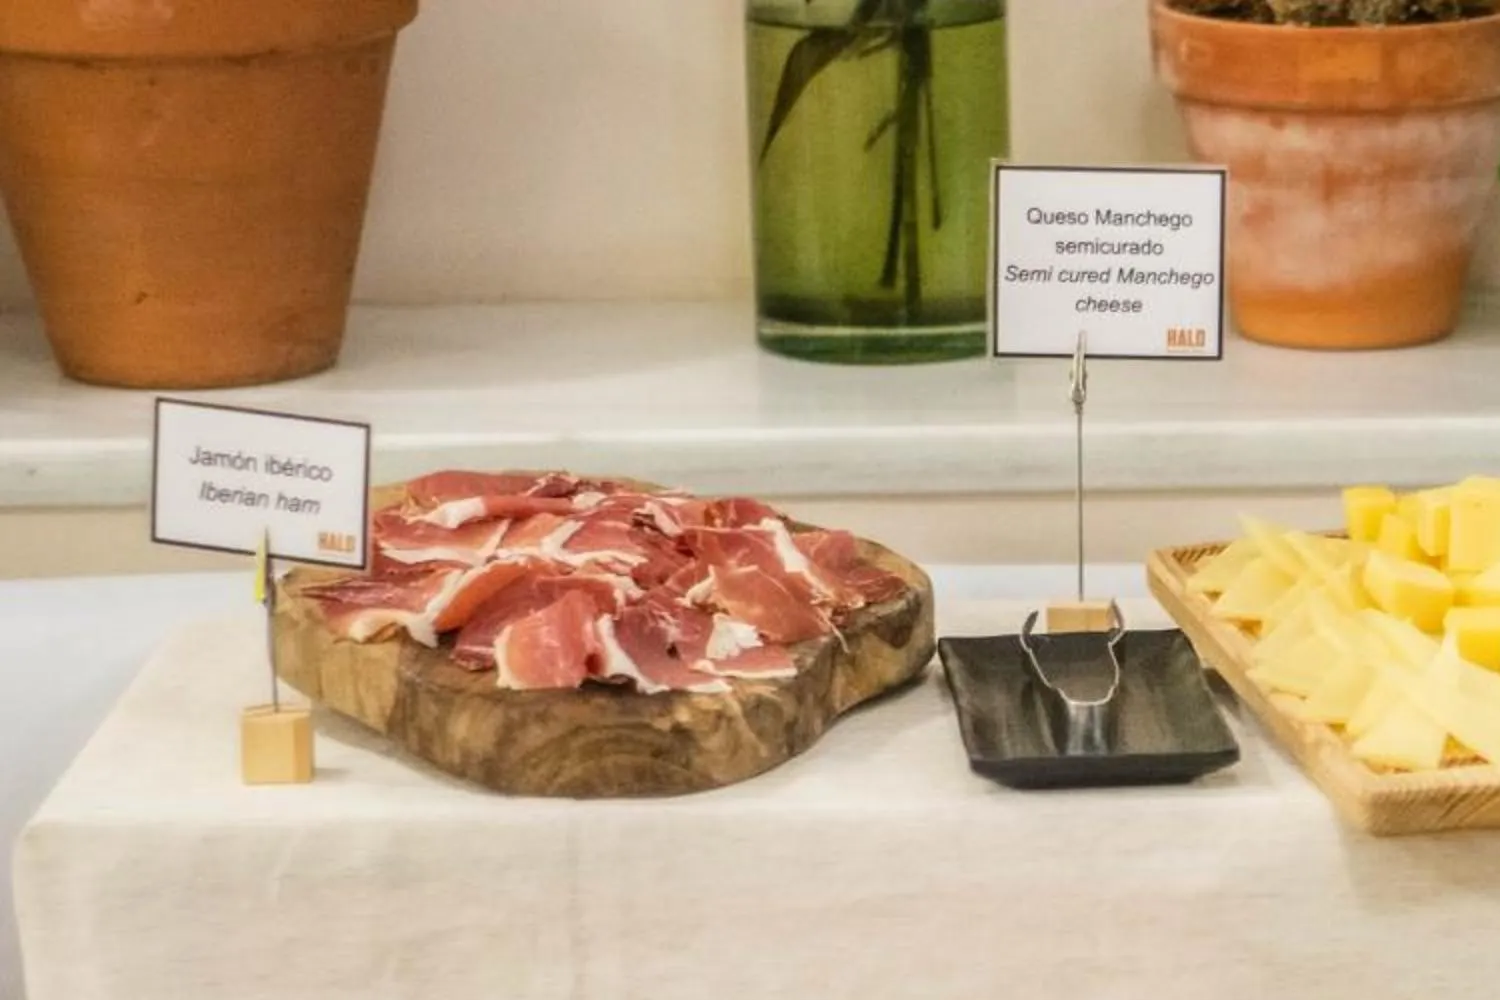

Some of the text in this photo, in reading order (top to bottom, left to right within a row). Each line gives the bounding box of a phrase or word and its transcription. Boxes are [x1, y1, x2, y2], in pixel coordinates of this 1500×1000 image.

[1026, 207, 1193, 230] Queso Manchego
[1055, 238, 1164, 256] semicurado
[1004, 265, 1214, 288] Semi cured Manchego
[1075, 296, 1143, 313] cheese
[1167, 329, 1205, 347] HALO
[189, 446, 333, 482] Jamón ibérico
[199, 481, 322, 515] Iberian ham
